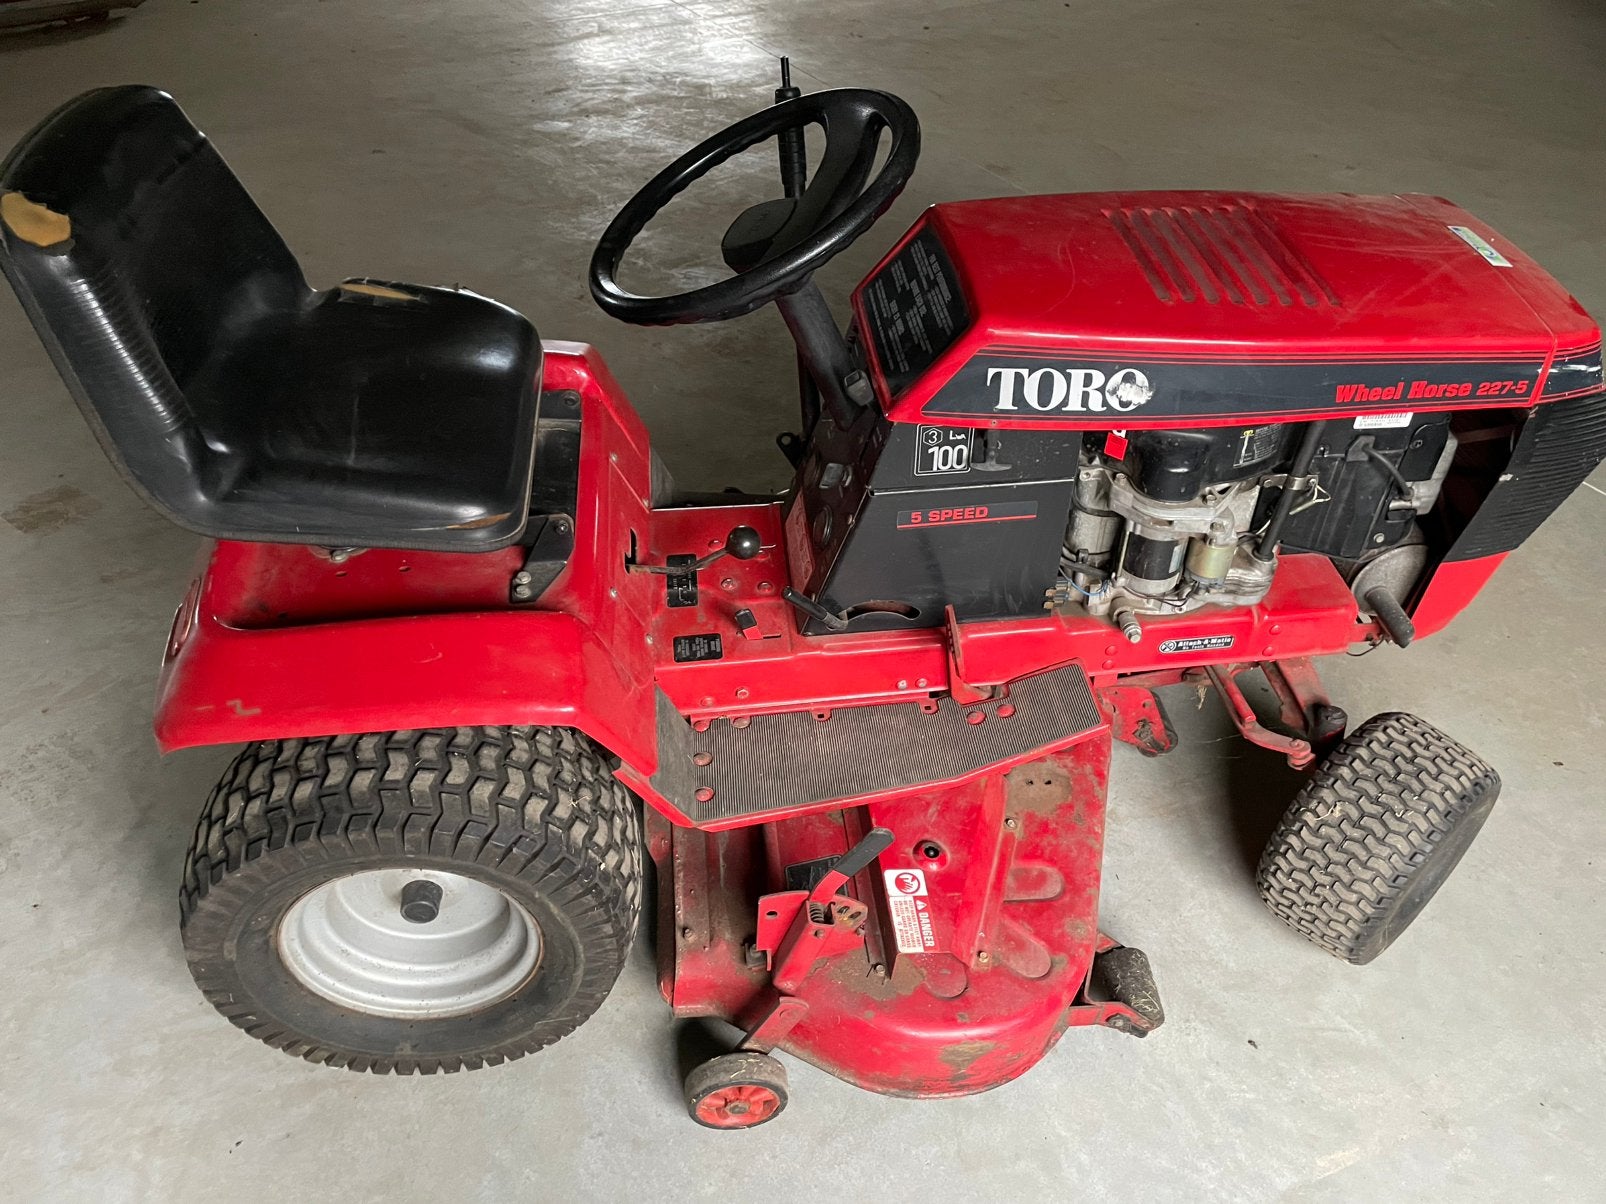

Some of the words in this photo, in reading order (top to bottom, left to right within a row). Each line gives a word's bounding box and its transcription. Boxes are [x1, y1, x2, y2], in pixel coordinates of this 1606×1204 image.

[986, 368, 1153, 411] TORO
[1336, 382, 1404, 402] Wheel
[1408, 380, 1472, 399] Horse
[1477, 380, 1529, 396] 227-5
[928, 444, 968, 471] 100
[911, 512, 922, 523] 5
[929, 507, 988, 521] SPEED
[919, 912, 935, 946] DANGER
